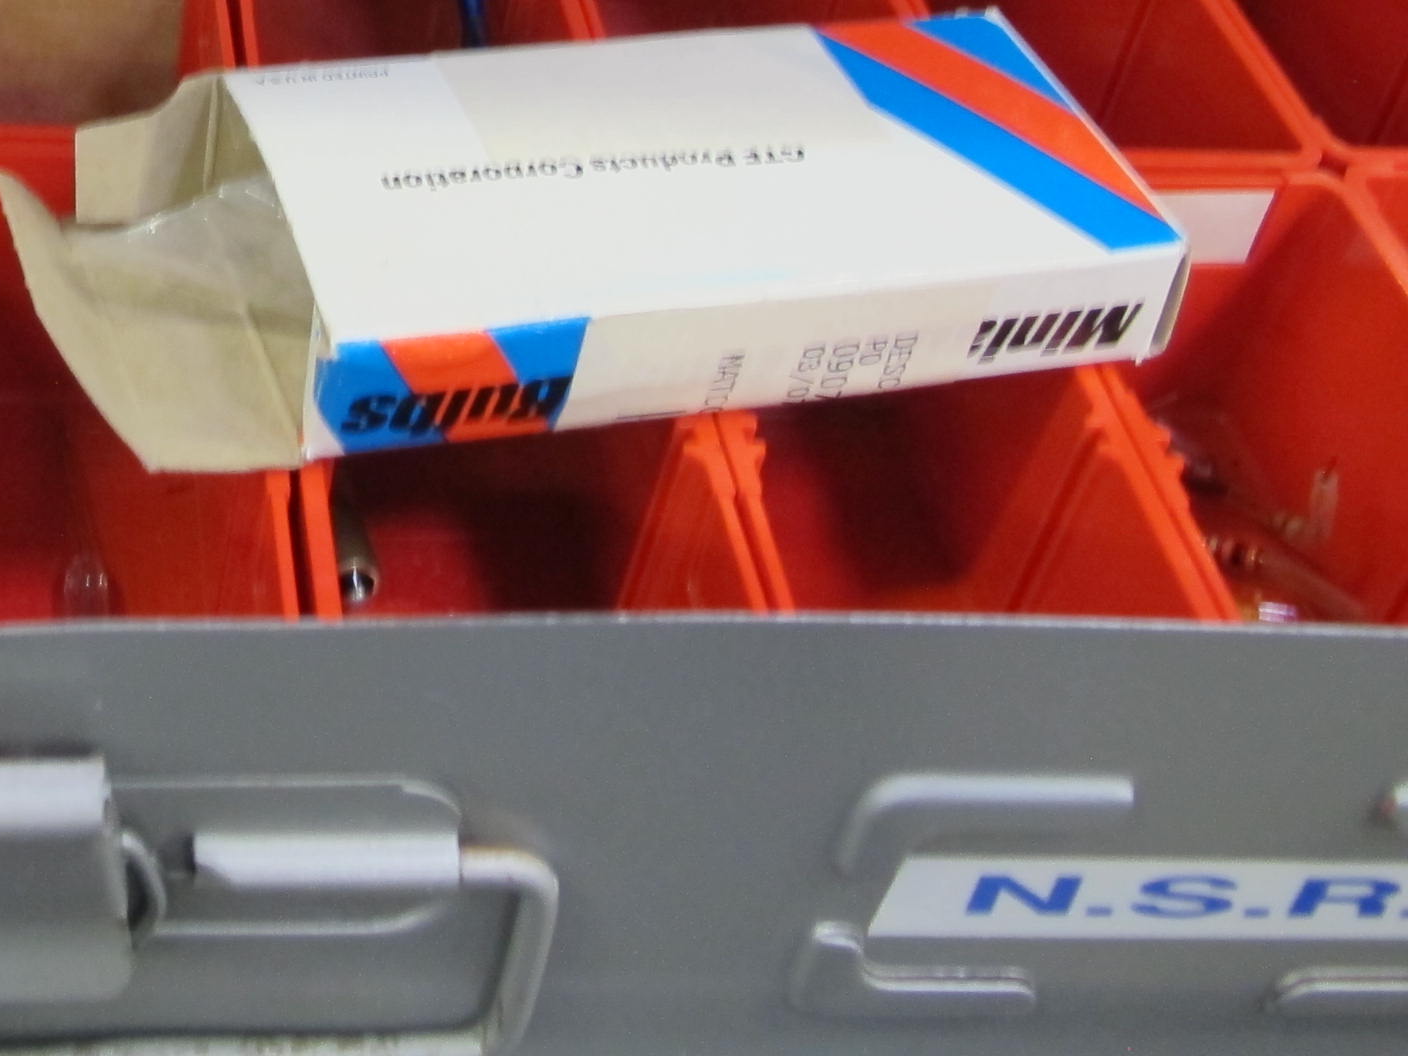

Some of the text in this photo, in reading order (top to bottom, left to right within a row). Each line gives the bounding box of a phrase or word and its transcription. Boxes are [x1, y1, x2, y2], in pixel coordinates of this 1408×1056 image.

[380, 155, 585, 192] Corporation
[590, 147, 738, 174] Products
[786, 343, 826, 403] 03/0
[341, 372, 575, 439] Bulbs
